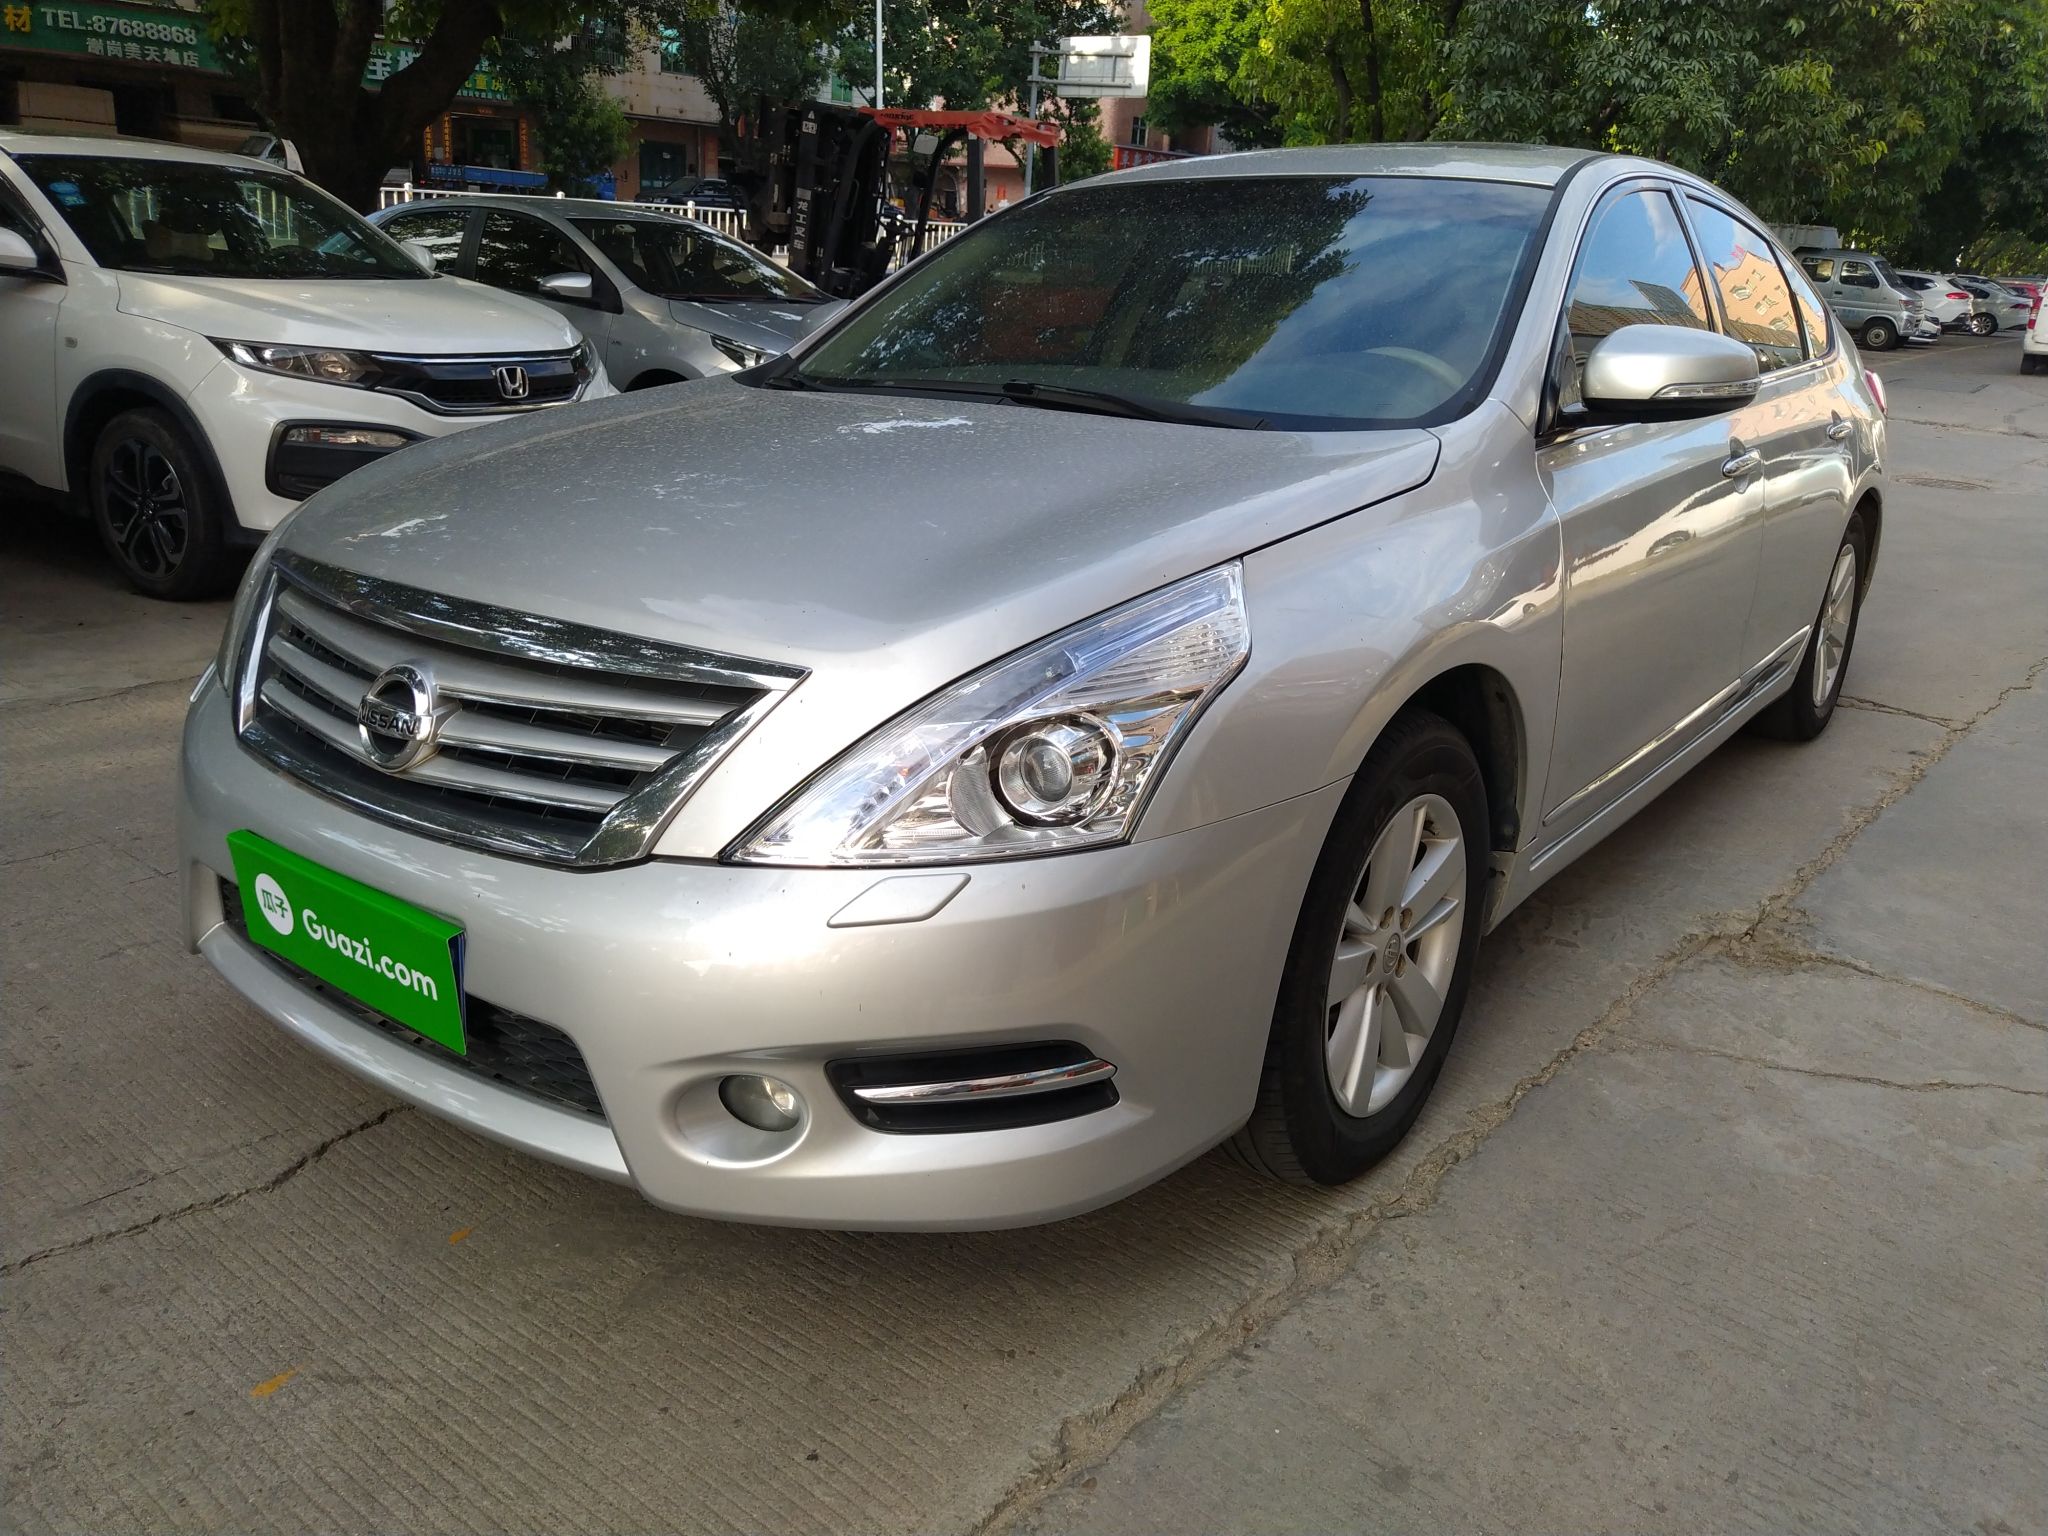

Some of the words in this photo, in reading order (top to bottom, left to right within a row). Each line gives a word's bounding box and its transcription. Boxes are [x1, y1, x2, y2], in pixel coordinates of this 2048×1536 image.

[4, 5, 31, 32] 材
[41, 8, 197, 45] TEL:87688868
[793, 201, 808, 250] 龙工叉车
[360, 702, 417, 736] NISSAN
[261, 888, 288, 919] 瓜子
[302, 908, 438, 1002] Guazi.com
